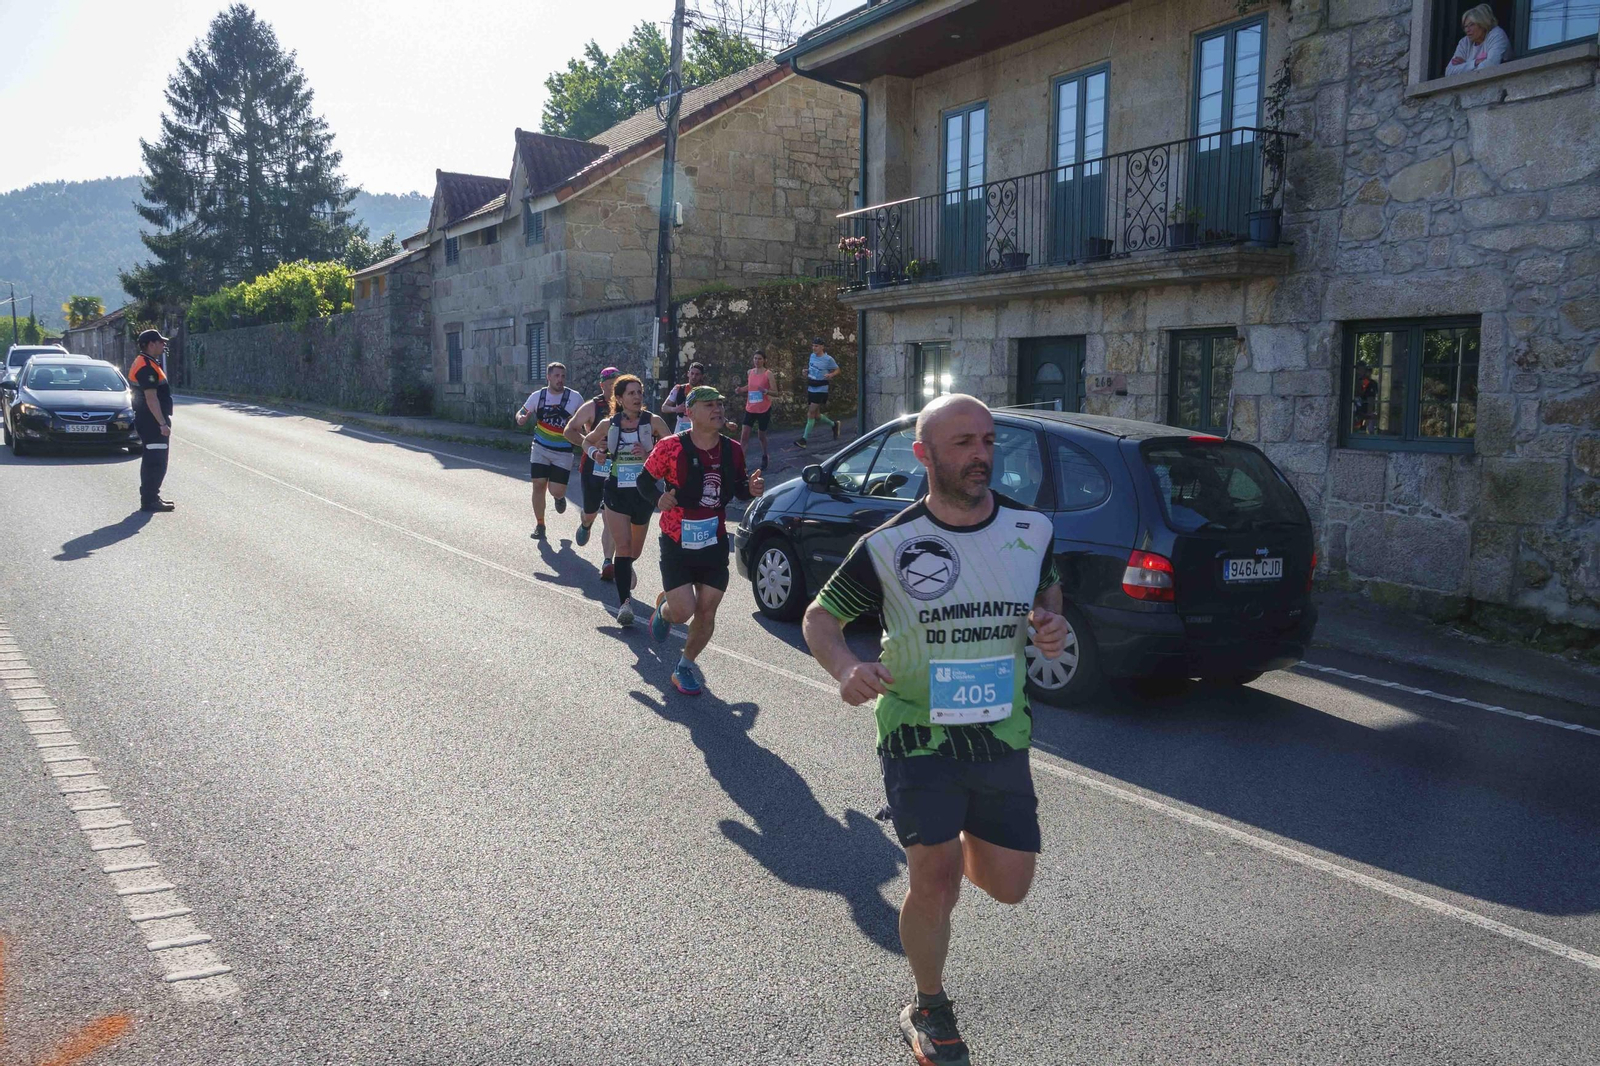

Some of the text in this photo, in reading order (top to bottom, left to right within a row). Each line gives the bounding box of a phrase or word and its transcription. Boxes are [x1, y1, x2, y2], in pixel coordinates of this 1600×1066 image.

[692, 530, 710, 541] 165
[1231, 560, 1281, 577] 9464 CJD
[919, 601, 1030, 624] CAMINHANTES
[926, 624, 1018, 644] DO CONDADO
[952, 683, 996, 705] 405
